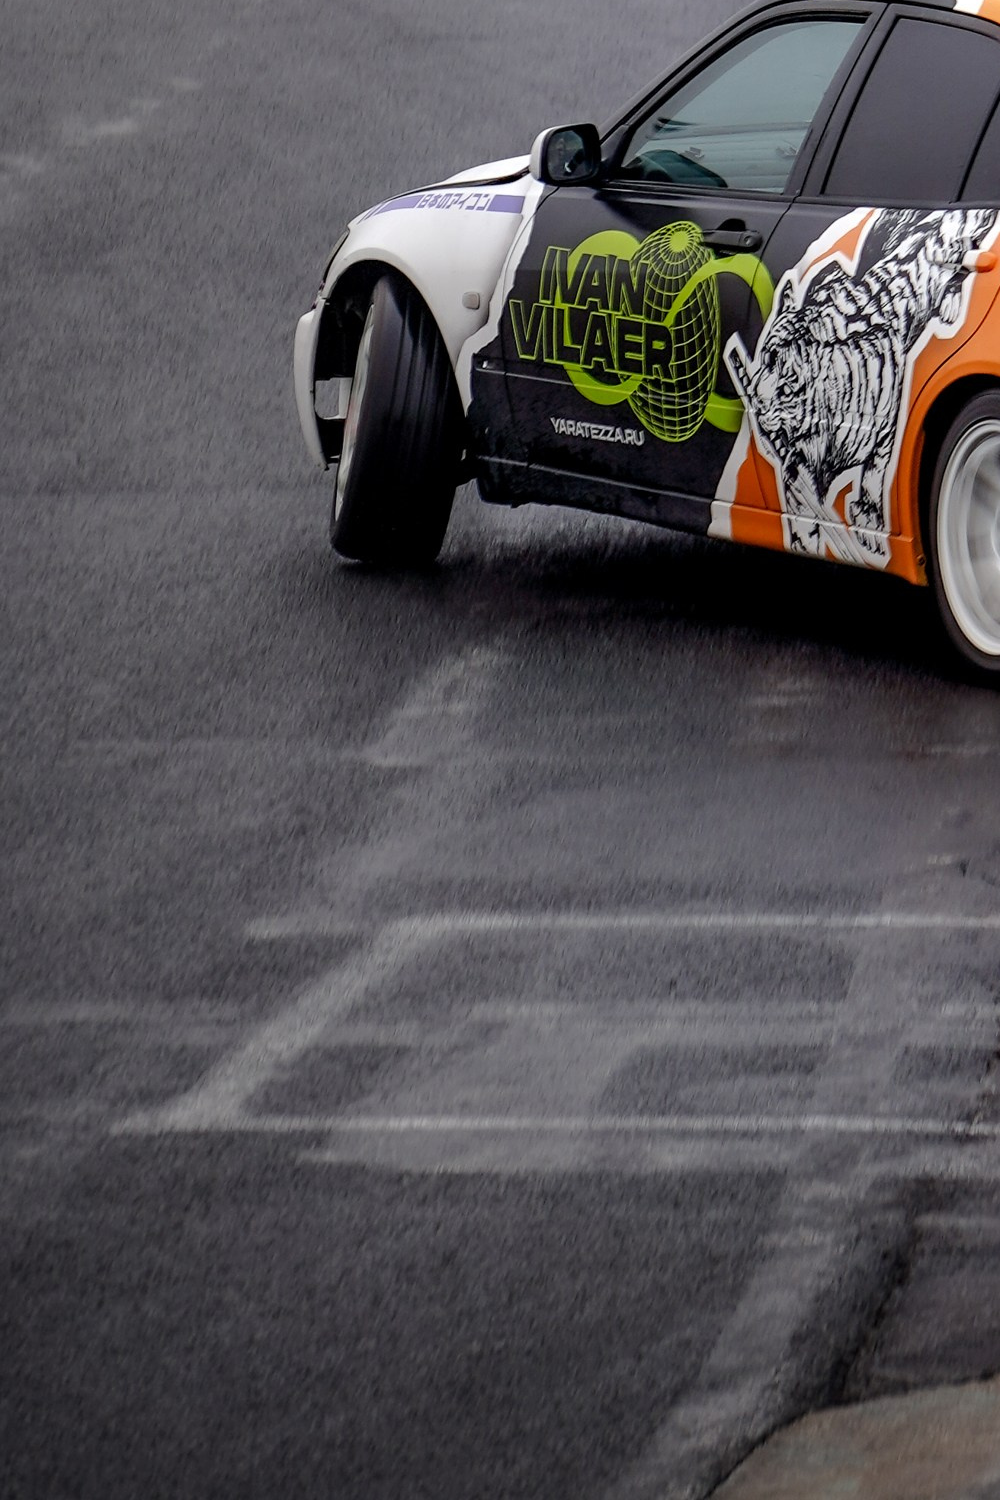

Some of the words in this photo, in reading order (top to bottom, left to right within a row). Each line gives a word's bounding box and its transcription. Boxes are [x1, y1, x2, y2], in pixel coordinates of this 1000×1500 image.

[539, 245, 650, 320] IVAN
[509, 299, 677, 384] VILAER
[550, 416, 645, 446] YARATEZZA.RU
